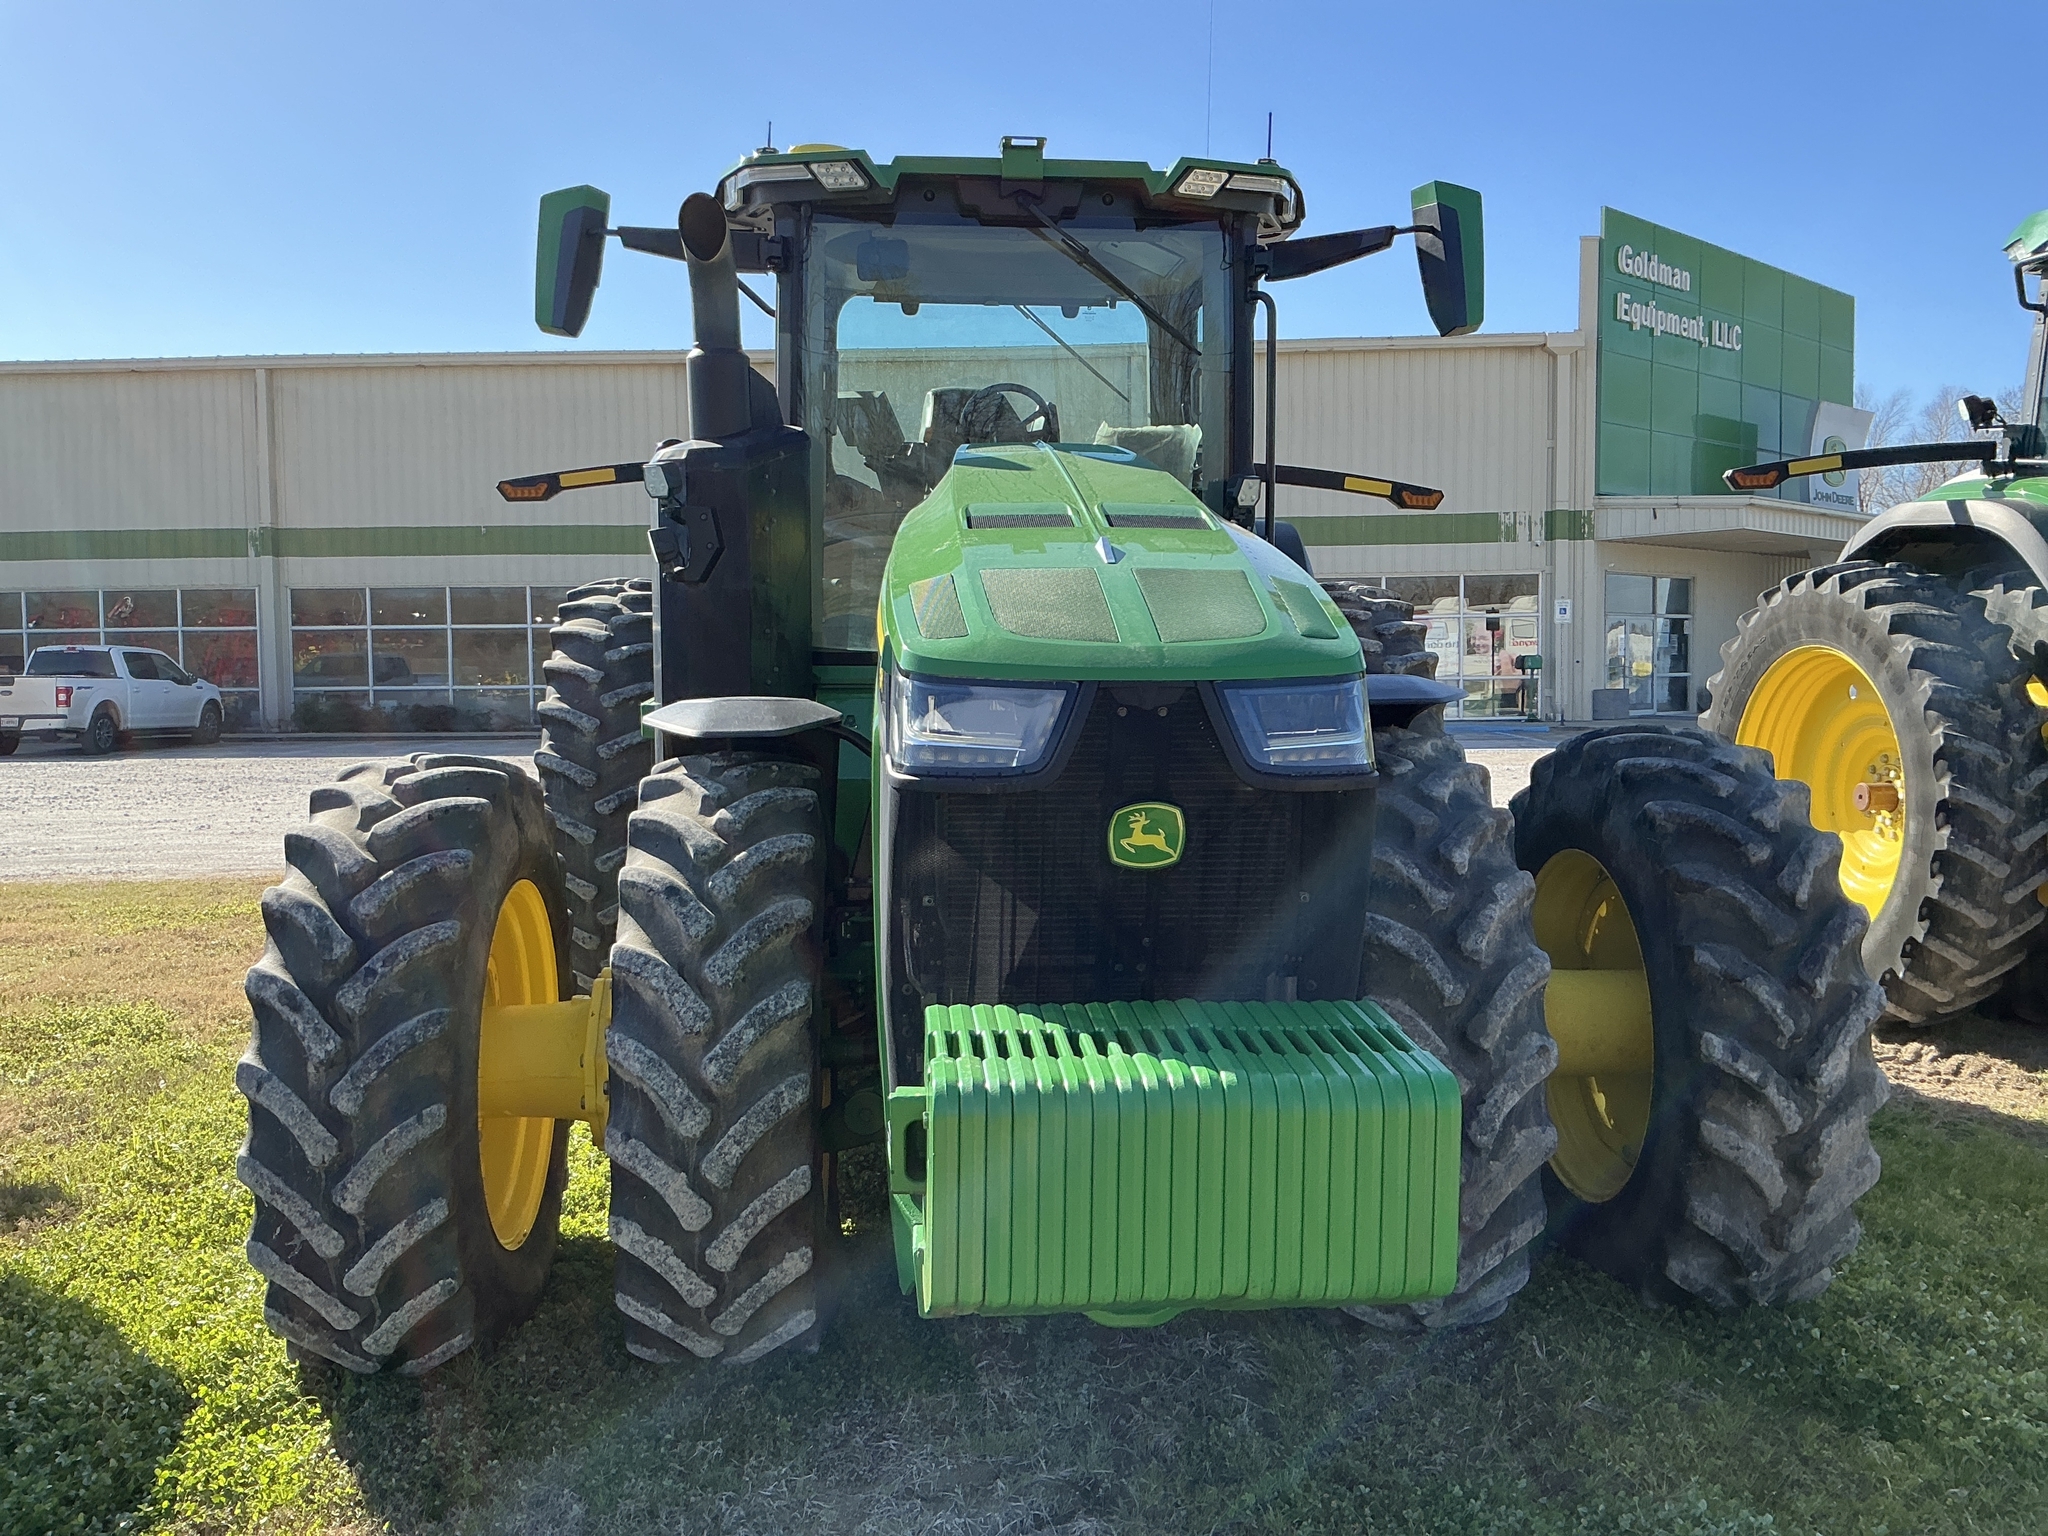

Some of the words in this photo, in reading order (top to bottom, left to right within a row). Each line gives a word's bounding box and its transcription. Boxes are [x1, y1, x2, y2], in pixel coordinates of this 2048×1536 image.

[1617, 244, 1691, 291] Goldman
[1616, 292, 1708, 348] Equipment,
[1711, 320, 1742, 351] LLC
[1813, 489, 1832, 503] JOHN
[1832, 491, 1855, 506] DEERE
